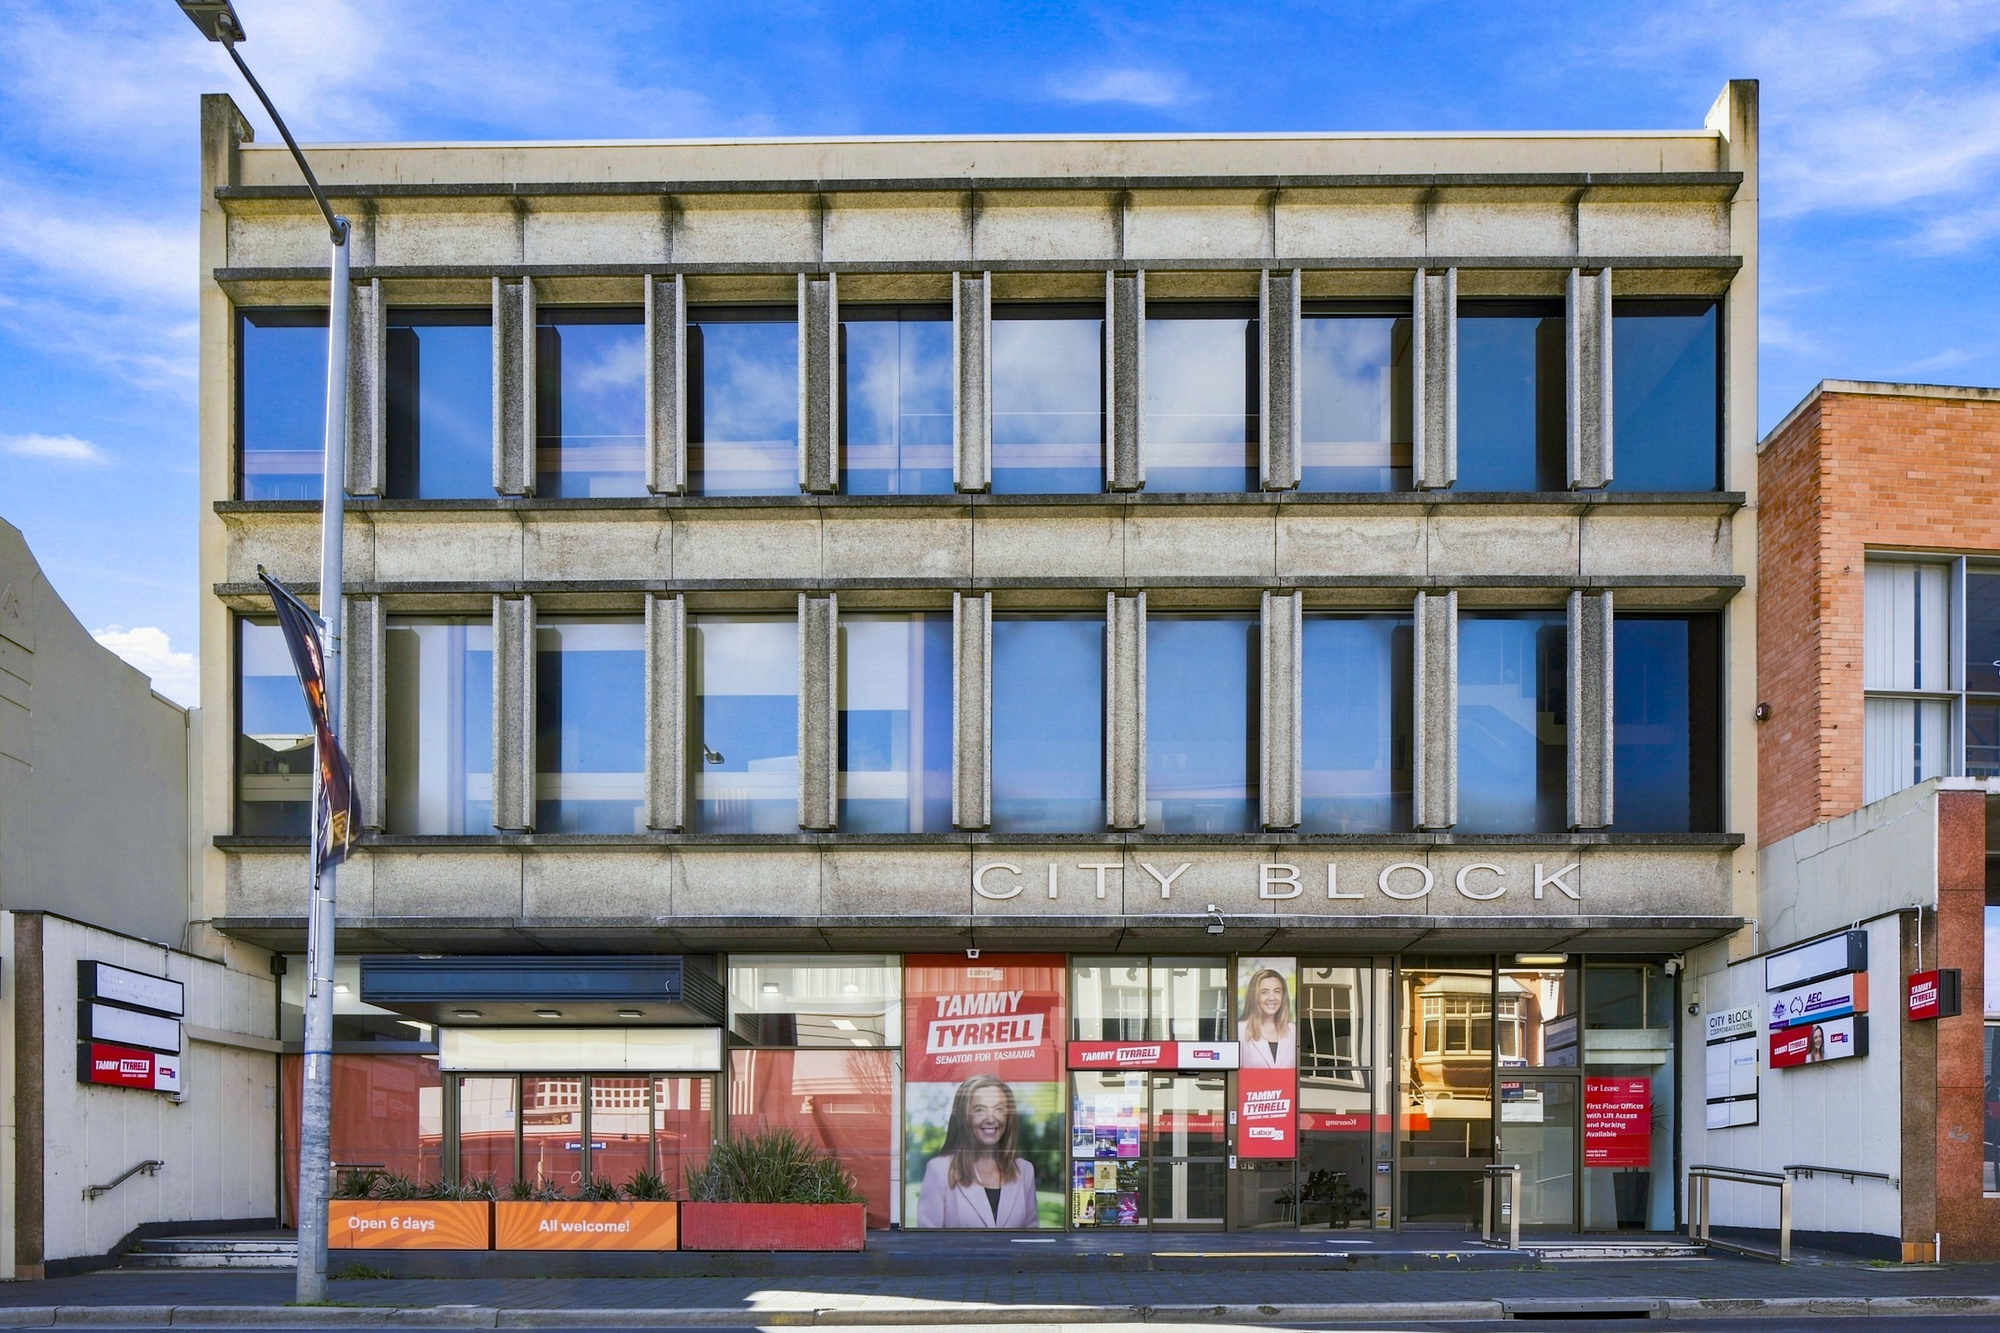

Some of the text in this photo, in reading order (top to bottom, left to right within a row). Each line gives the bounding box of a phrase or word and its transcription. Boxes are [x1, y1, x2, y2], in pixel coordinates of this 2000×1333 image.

[972, 862, 1582, 899] CITY BLOCK
[1911, 981, 1932, 994] TAMMY
[935, 990, 1025, 1017] TAMMY
[1806, 991, 1823, 1004] AEC
[1709, 1009, 1753, 1028] CITY BLOCK
[935, 1019, 1035, 1048] TYRRELL
[1710, 1020, 1753, 1036] CORPORATE CENTRE
[1831, 1034, 1843, 1042] Labor
[935, 1049, 1036, 1065] SENATOR FOR TASMANIA
[1081, 1048, 1158, 1062] TAMMY TYRRELL
[95, 1060, 119, 1070] TAMMY
[1587, 1084, 1598, 1092] For
[1600, 1084, 1620, 1092] Lease
[1246, 1090, 1282, 1101] TAMMY
[1246, 1101, 1287, 1113] TYRRELL
[348, 1216, 435, 1231] Open 6 days
[538, 1219, 630, 1233] All welcome!
